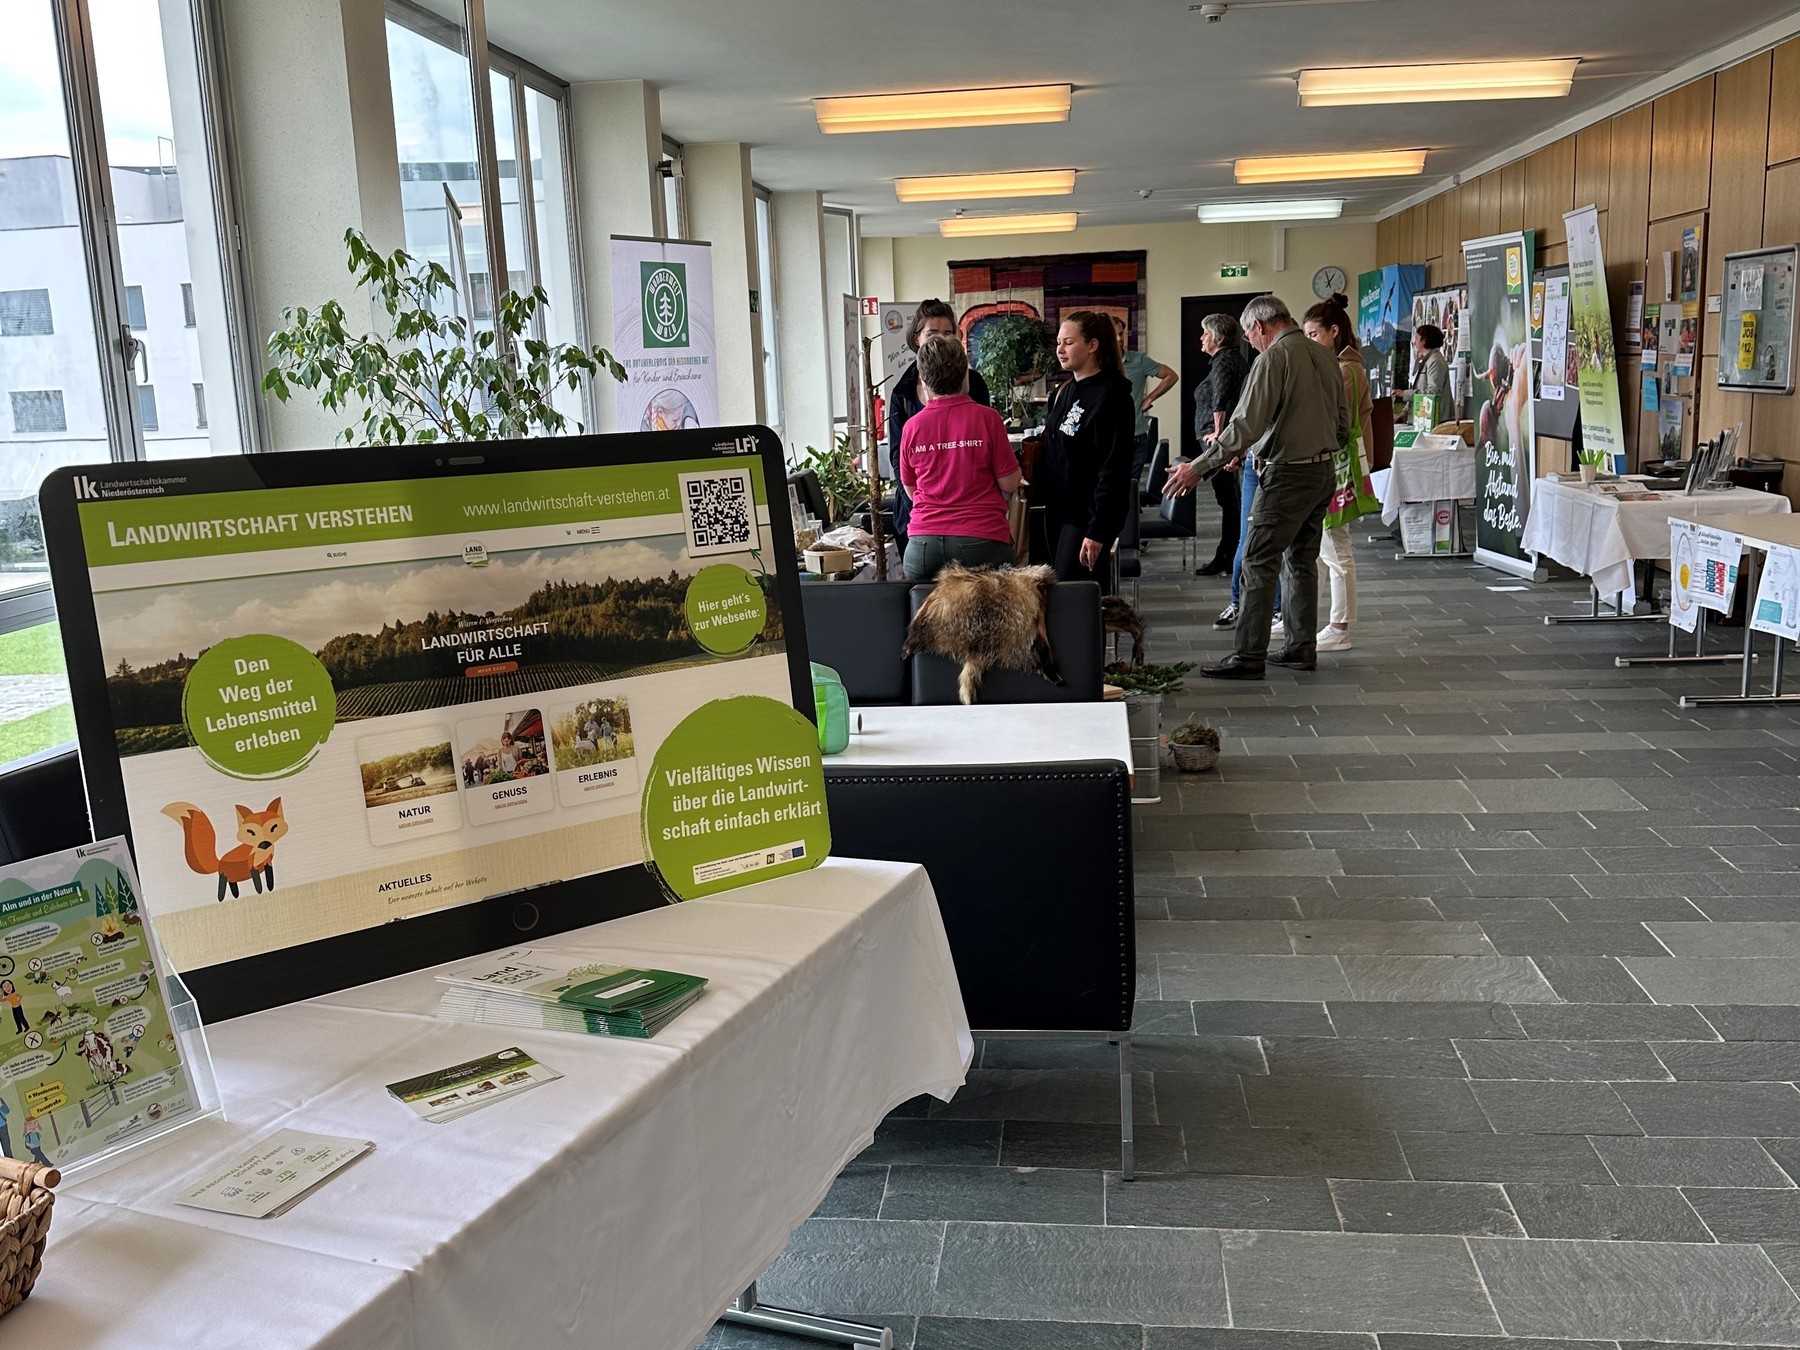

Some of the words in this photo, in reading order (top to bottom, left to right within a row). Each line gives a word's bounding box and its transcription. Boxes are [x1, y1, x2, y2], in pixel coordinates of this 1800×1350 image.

[649, 272, 681, 296] WUNDERWELT
[656, 323, 677, 338] WALD
[668, 357, 676, 366] DER
[641, 370, 661, 384] Kinder
[662, 370, 674, 382] und
[915, 445, 926, 453] AM
[937, 440, 983, 450] TREE-SHIRT
[73, 475, 99, 499] lk
[100, 477, 187, 489] Landwirtschaftskammer
[101, 486, 165, 498] Niederösterreich
[1484, 469, 1518, 499] Abstand
[463, 487, 671, 517] www.landwirtschaft-verstehen.at
[465, 545, 483, 553] LAND
[698, 600, 719, 613] Hier
[722, 593, 751, 610] geht's
[694, 620, 710, 631] zur
[711, 609, 760, 627] Webseite:
[421, 622, 549, 650] LANDWIRTSCHAFT
[457, 648, 485, 664] FÜR
[488, 643, 522, 660] ALLE
[234, 658, 270, 676] Den
[219, 685, 261, 704] Weg
[265, 678, 293, 695] der
[205, 696, 317, 733] Lebensmittel
[234, 728, 300, 753] erleben
[578, 768, 618, 784] ERLEBNIS
[665, 763, 753, 787] Vielfältiges
[756, 754, 811, 775] Wissen
[492, 786, 528, 800] GENUSS
[672, 795, 708, 813] über
[711, 788, 735, 806] die
[739, 778, 809, 802] Landwirt-
[398, 805, 431, 819] NATUR
[662, 817, 711, 841] schaft
[714, 809, 770, 833] einfach
[774, 800, 822, 821] erklärt
[378, 873, 432, 893] AKTUELLES
[443, 882, 454, 892] auf
[455, 881, 464, 889] der
[2, 901, 17, 913] Alm
[18, 898, 31, 908] und
[33, 894, 40, 903] in
[41, 891, 53, 901] der
[53, 887, 73, 898] Natur
[472, 966, 519, 981] Land
